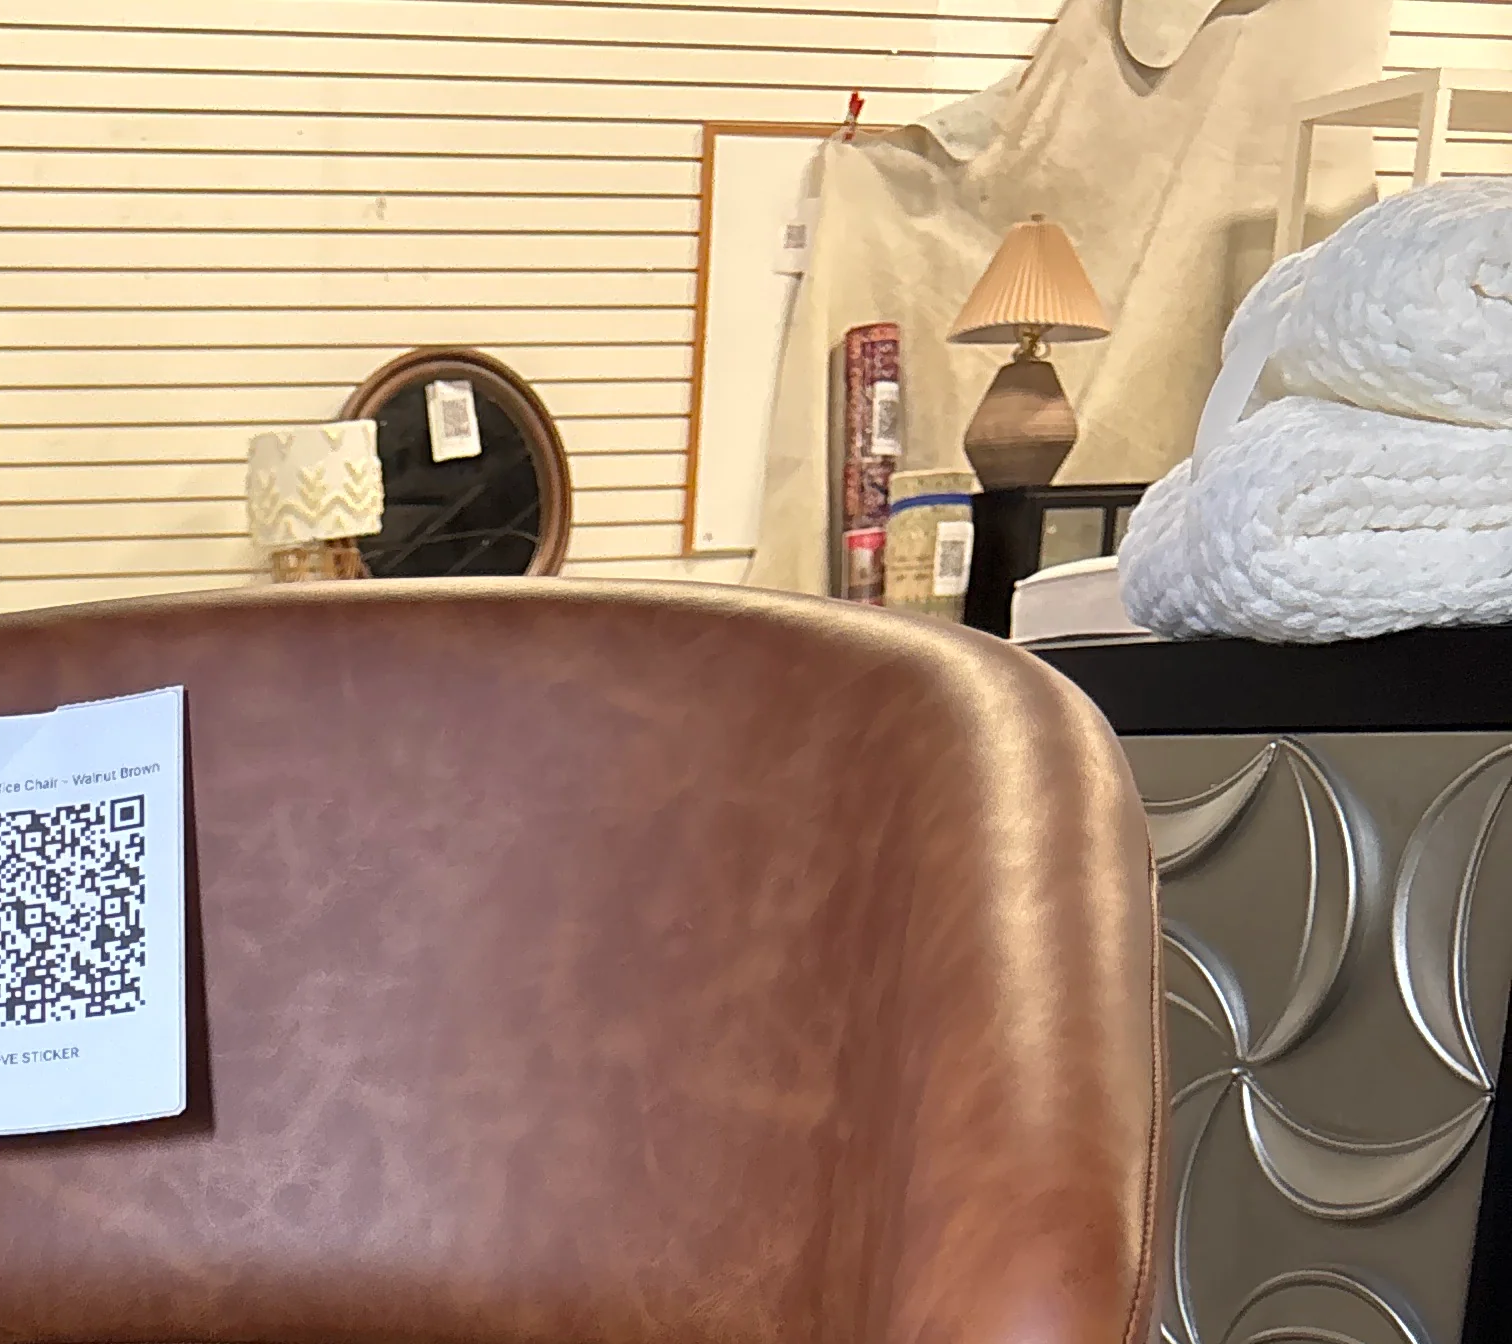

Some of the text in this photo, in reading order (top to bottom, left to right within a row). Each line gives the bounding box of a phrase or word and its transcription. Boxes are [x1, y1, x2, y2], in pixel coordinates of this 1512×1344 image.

[24, 777, 58, 791] Chair
[72, 770, 117, 786] Walnut
[120, 762, 161, 780] Brown
[22, 1046, 80, 1064] STICKER
